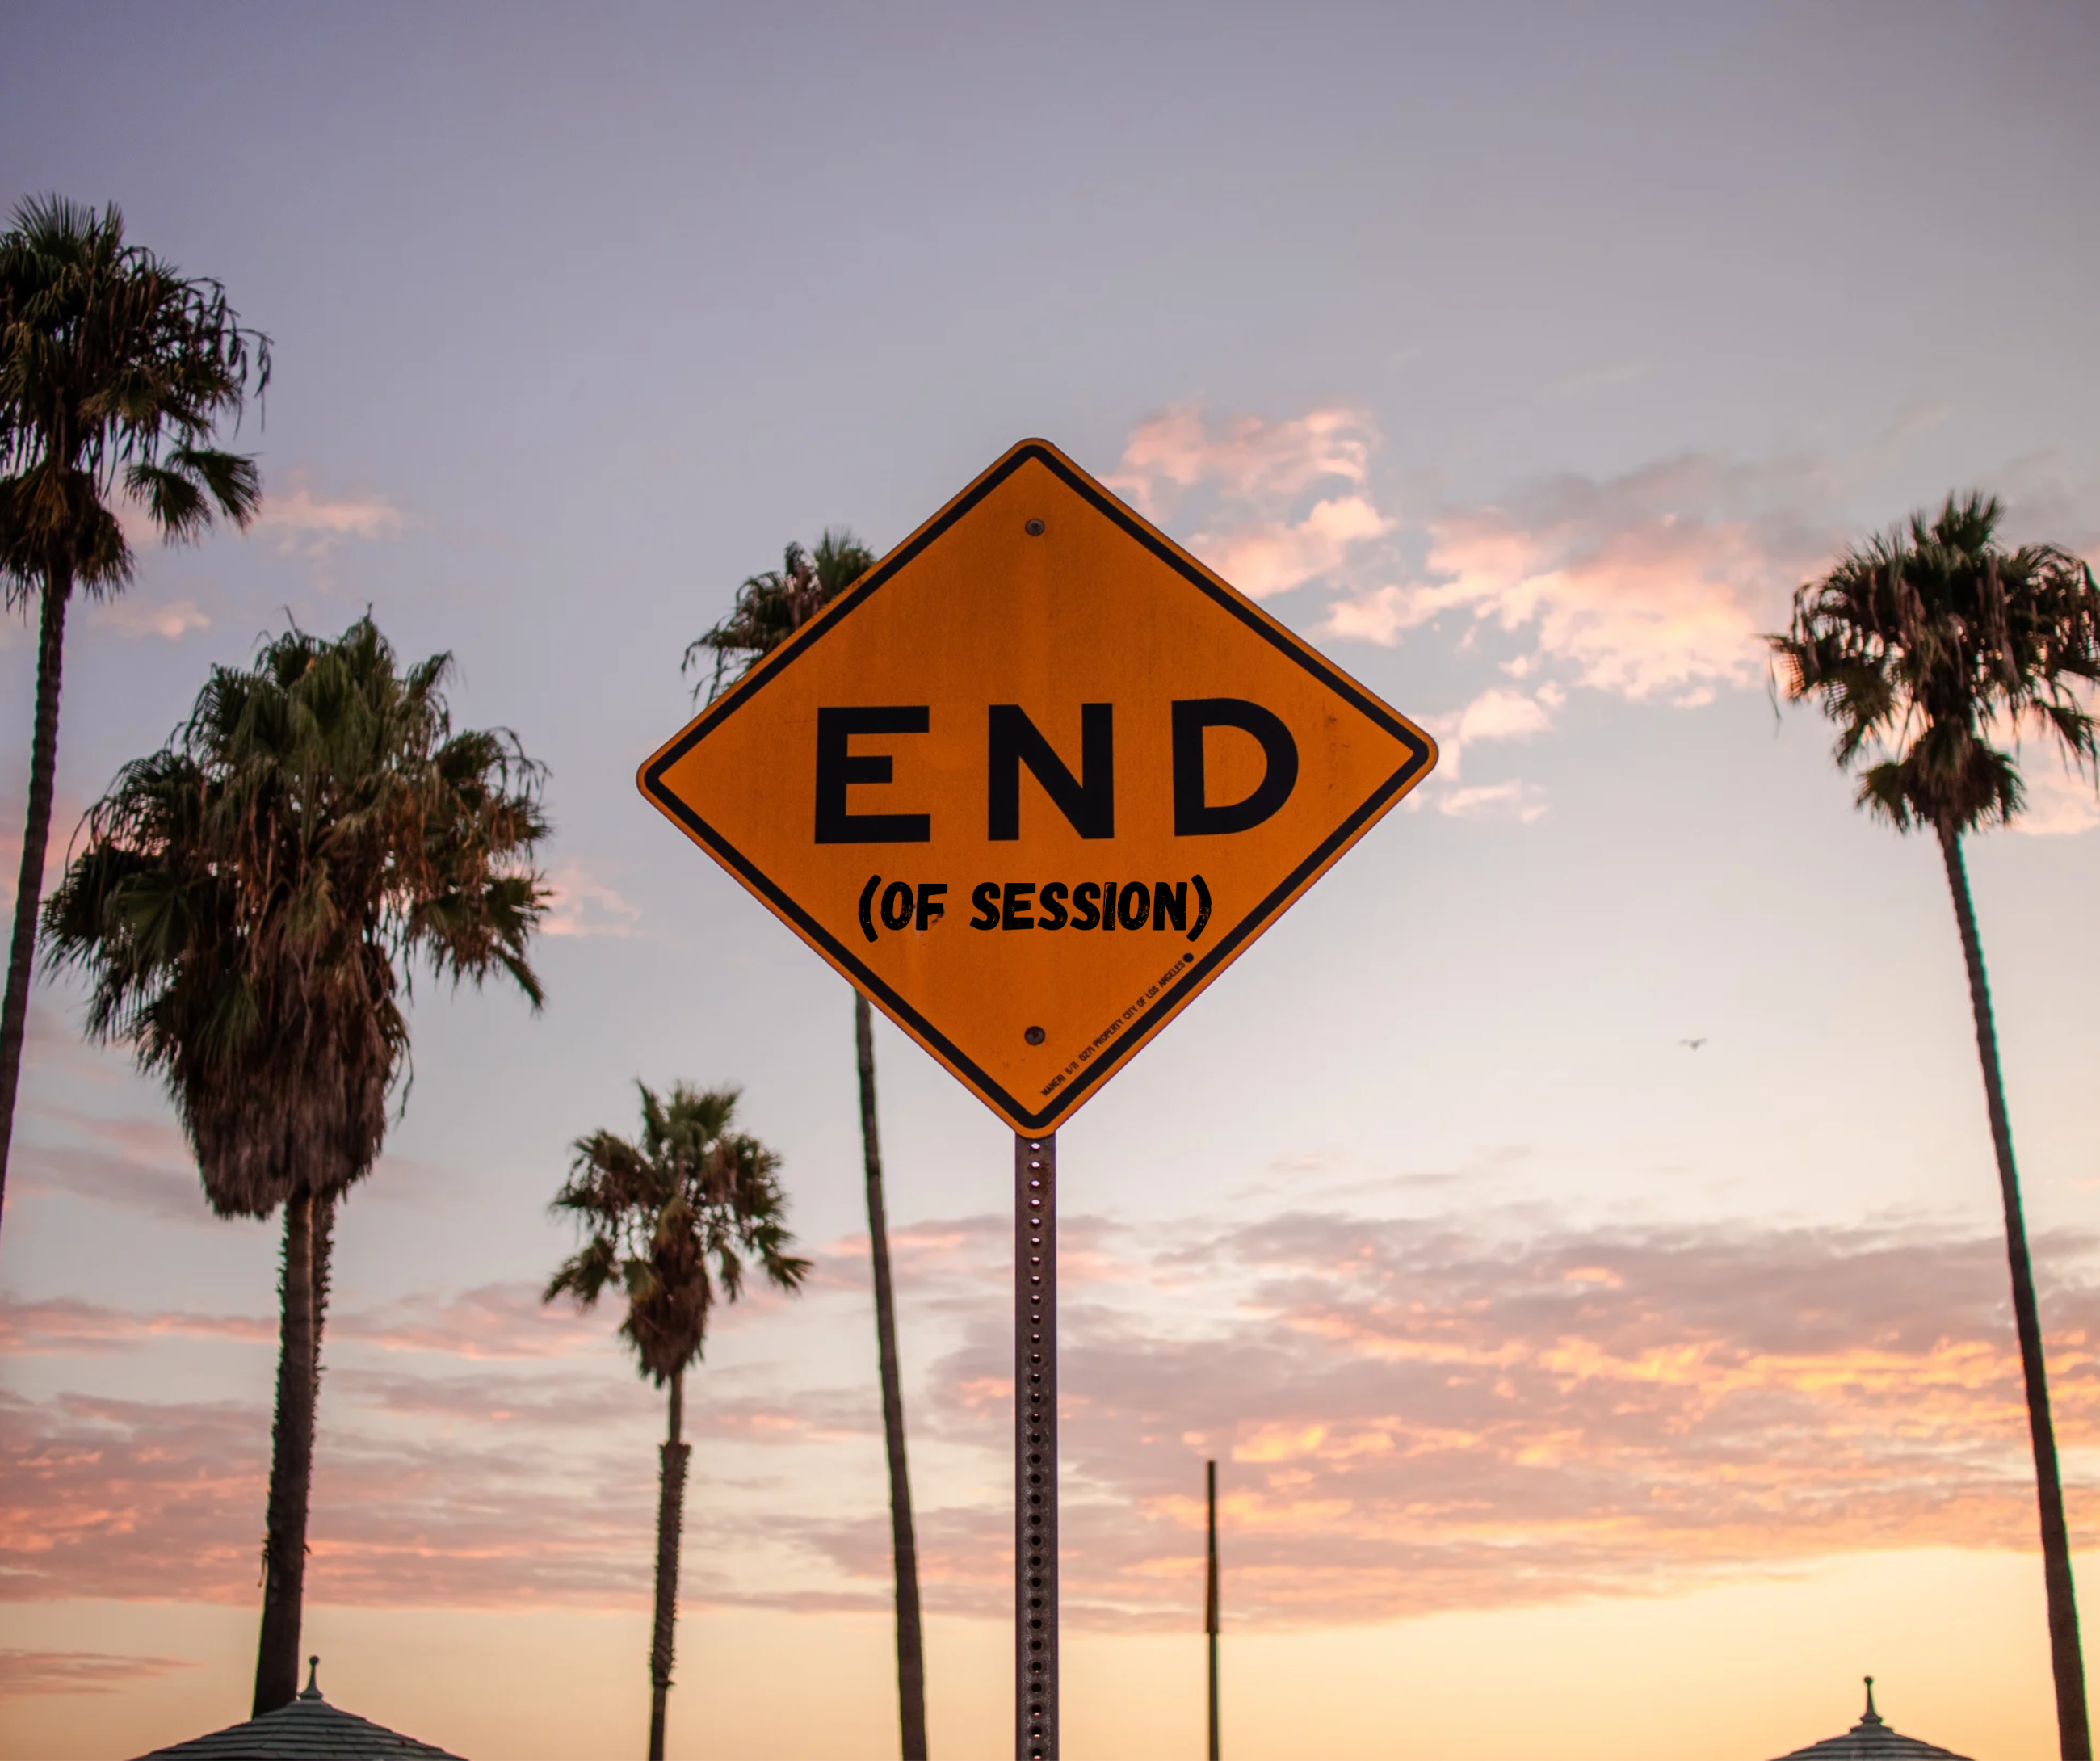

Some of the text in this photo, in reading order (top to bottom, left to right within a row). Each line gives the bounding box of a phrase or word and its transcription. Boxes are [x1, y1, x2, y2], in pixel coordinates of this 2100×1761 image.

[814, 697, 1300, 844] END
[1093, 1019, 1124, 1048] PROPERTY
[1123, 1005, 1138, 1020] CITY
[1136, 996, 1147, 1007] OF
[1145, 985, 1160, 998] LOS
[1157, 960, 1186, 987] ANGELES
